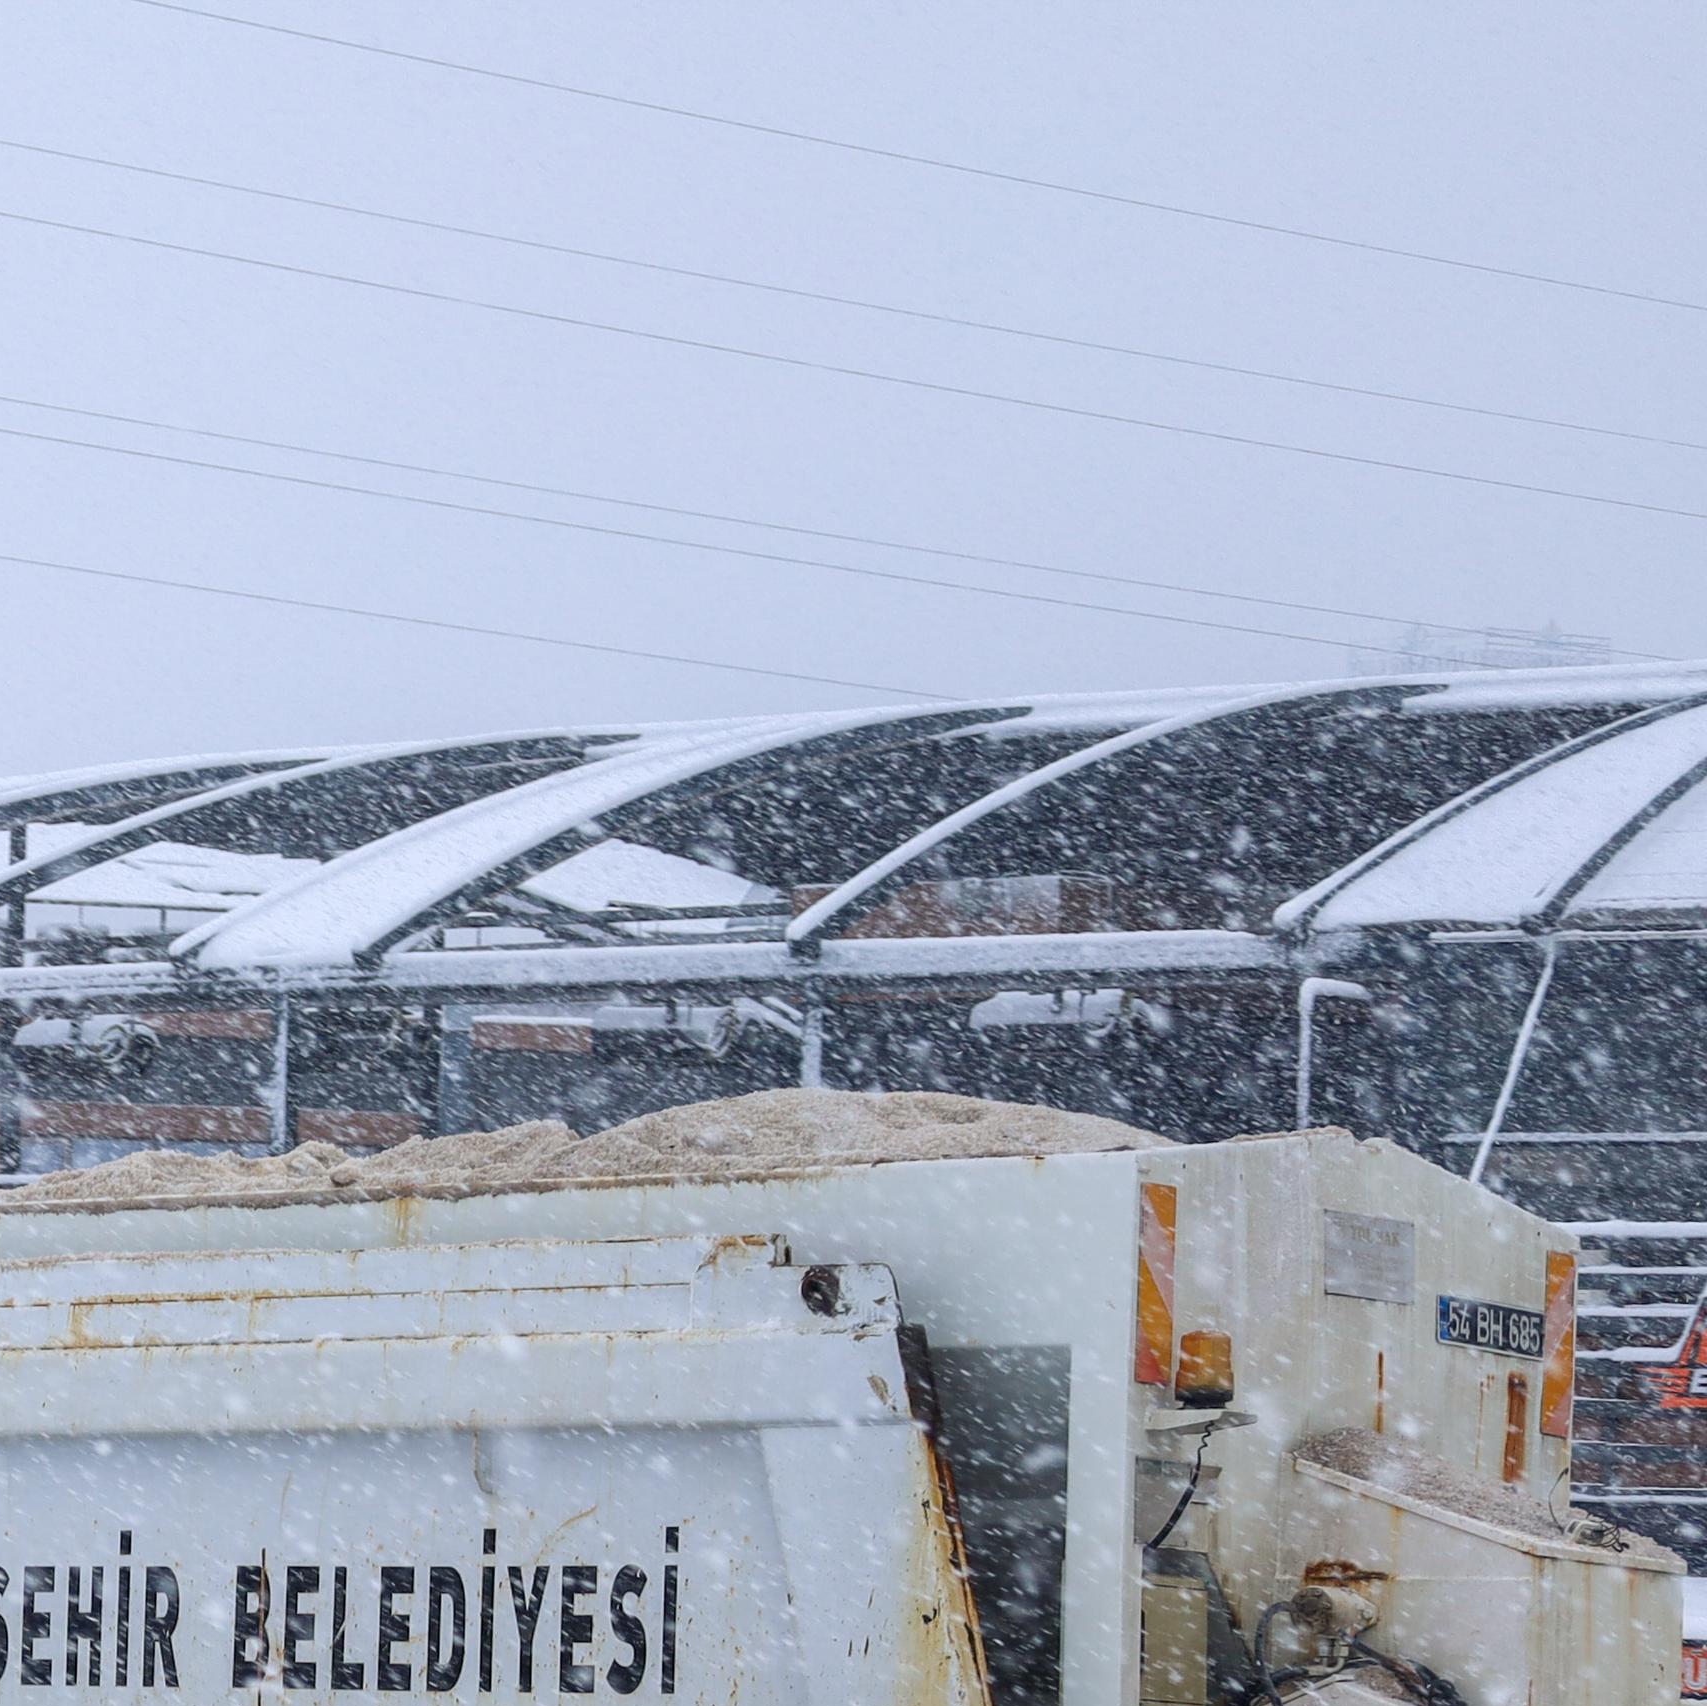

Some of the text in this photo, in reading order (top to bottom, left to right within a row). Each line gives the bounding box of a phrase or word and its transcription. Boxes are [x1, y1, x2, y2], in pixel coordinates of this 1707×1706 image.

[1448, 1300, 1542, 1352] 54 BH 685
[231, 1525, 680, 1696] BELEDİYESİ
